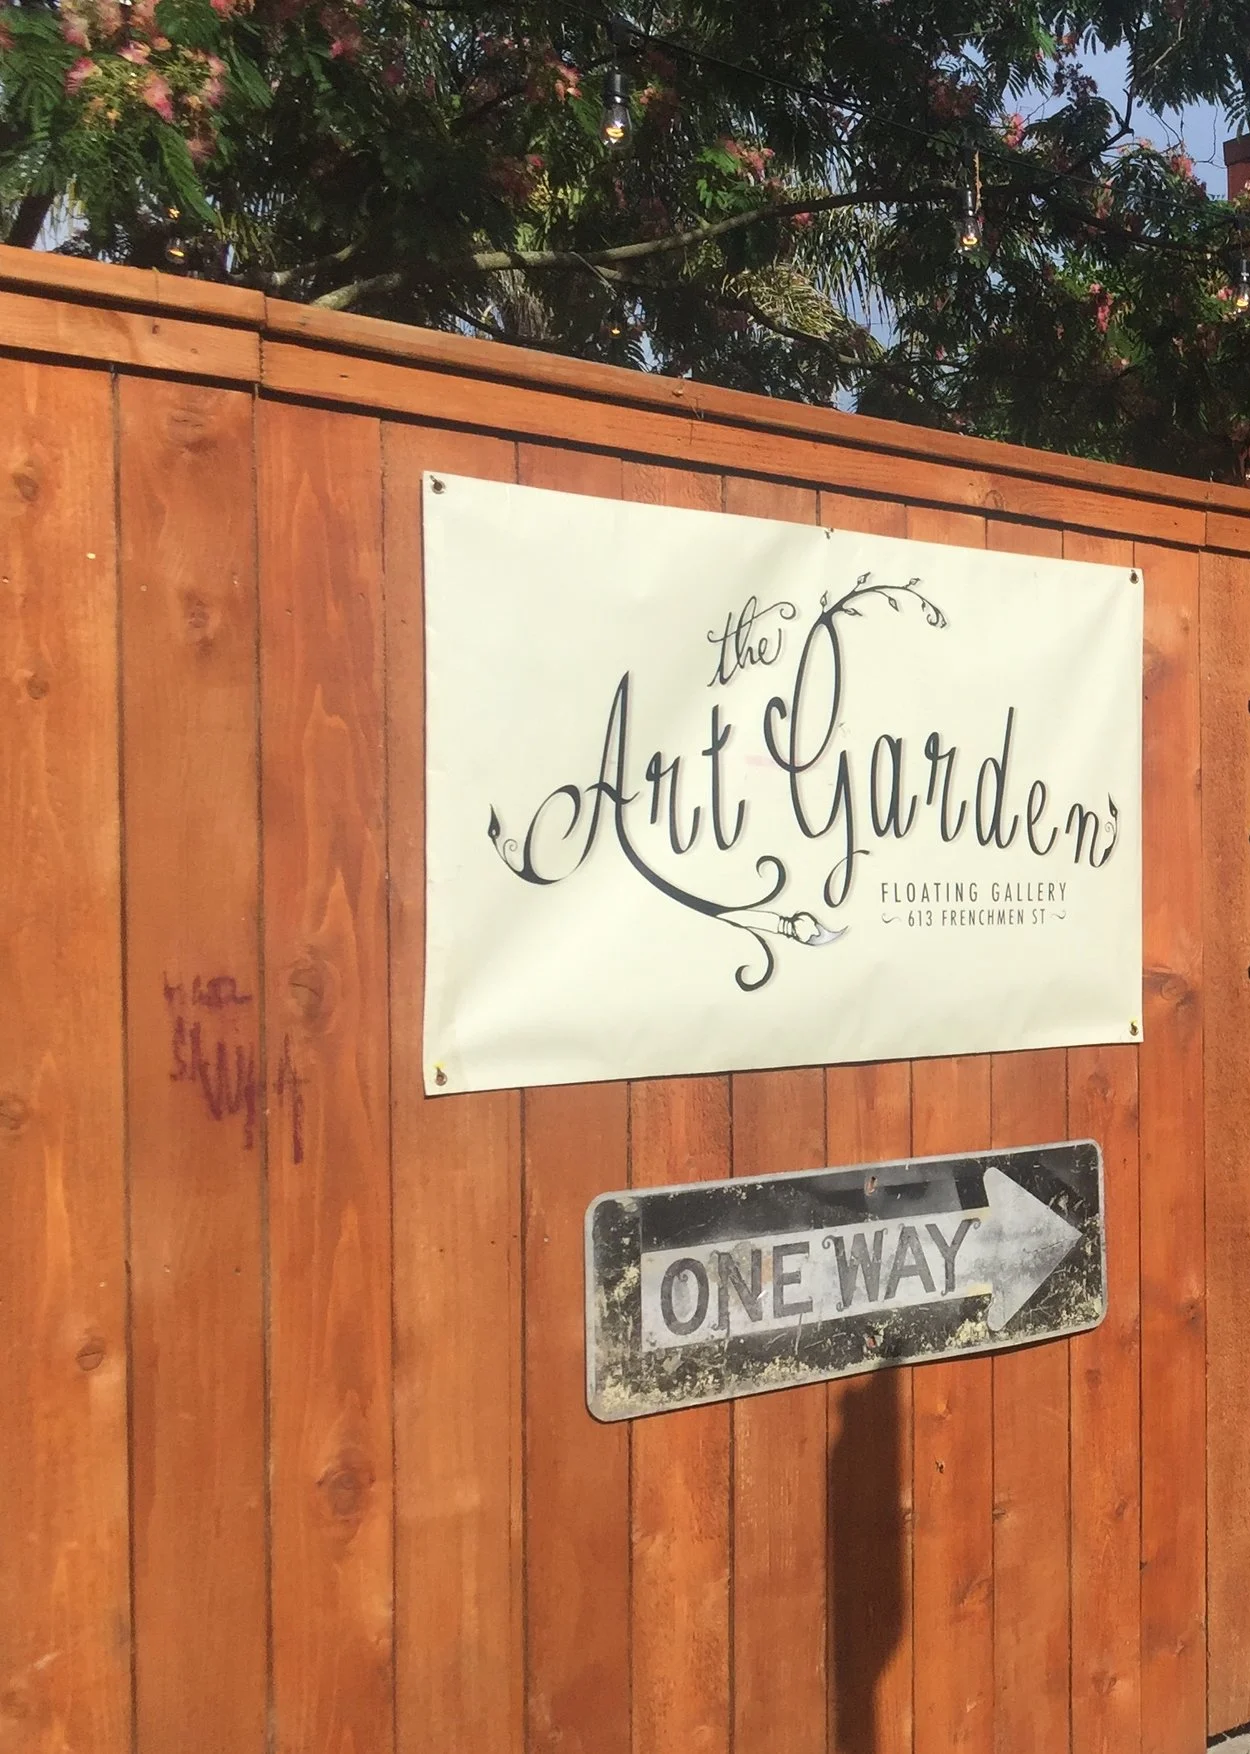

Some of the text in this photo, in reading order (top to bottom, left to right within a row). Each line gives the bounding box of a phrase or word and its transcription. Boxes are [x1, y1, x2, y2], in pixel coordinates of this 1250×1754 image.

[706, 596, 797, 688] the
[488, 612, 1118, 915] Art Garden
[881, 881, 1067, 903] FLOATING GALLERY
[908, 908, 1046, 928] 613 FRENCHMEN ST
[660, 1217, 982, 1336] ONE WAY
